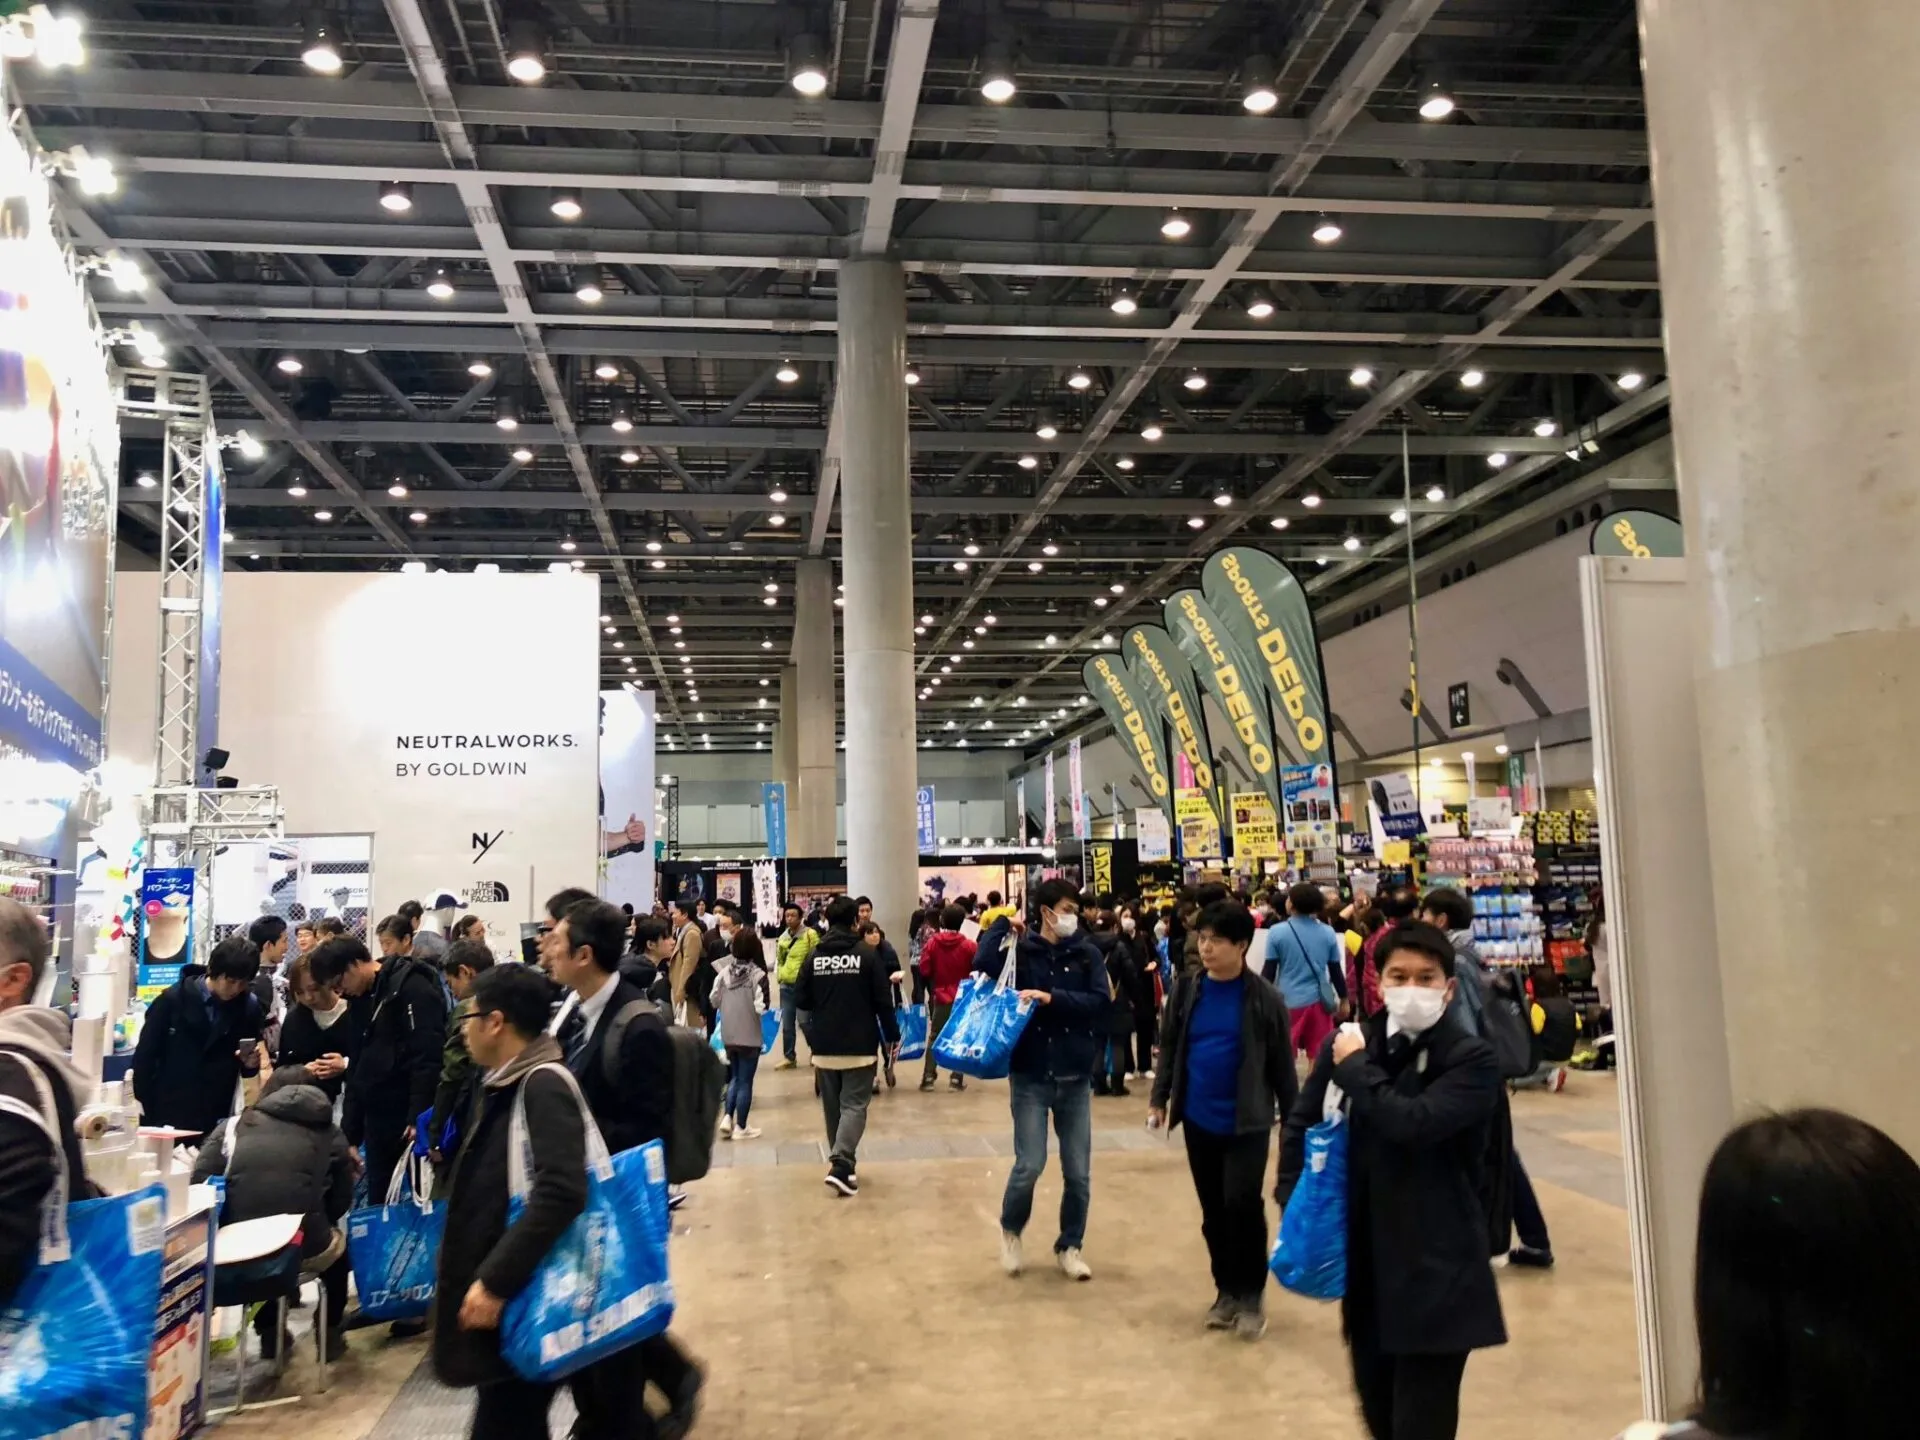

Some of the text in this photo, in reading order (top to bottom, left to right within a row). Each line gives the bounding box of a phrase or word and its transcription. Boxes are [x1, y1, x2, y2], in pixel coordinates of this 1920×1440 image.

[397, 734, 579, 749] NEUTRALWORKS.
[396, 762, 527, 776] BY GOLDWIN
[1094, 849, 1111, 892] レジ入口
[471, 895, 493, 903] FACE
[813, 954, 861, 970] EPSON
